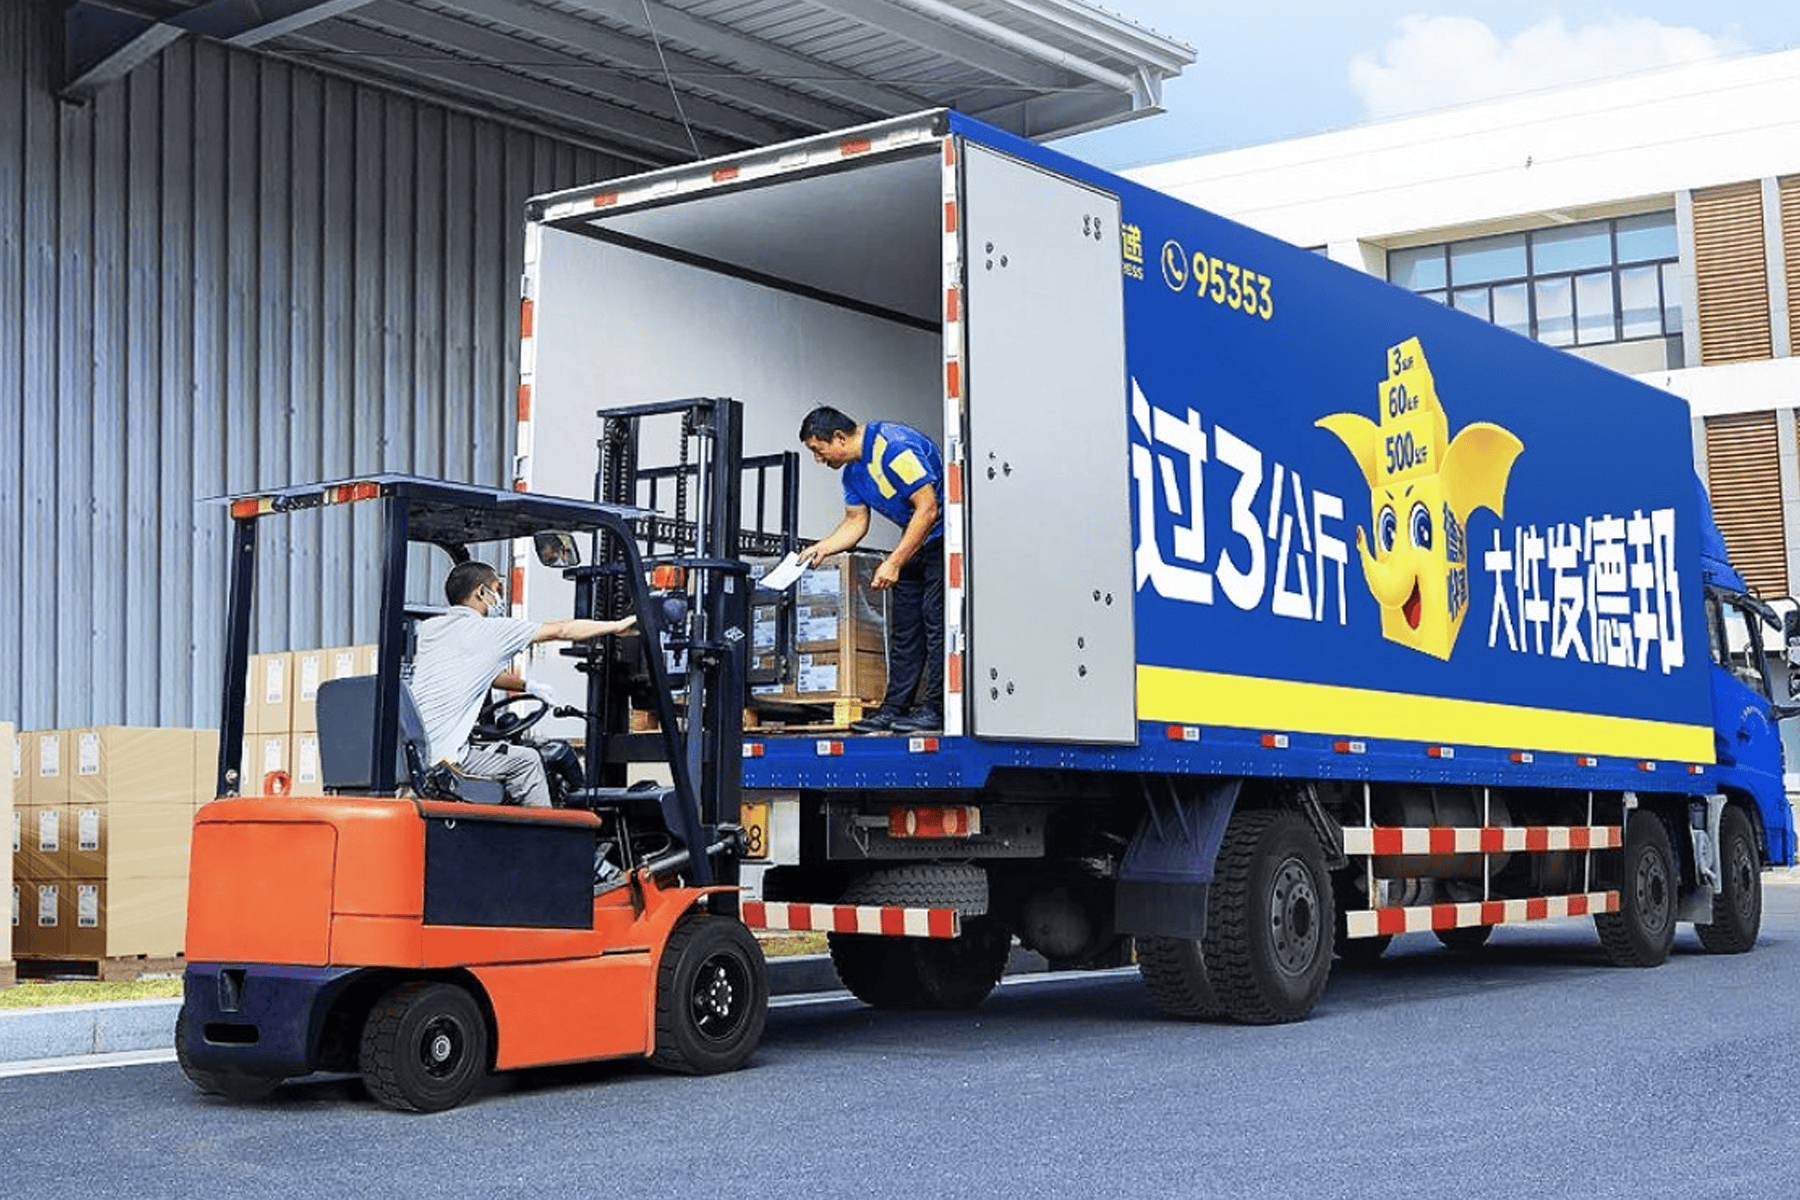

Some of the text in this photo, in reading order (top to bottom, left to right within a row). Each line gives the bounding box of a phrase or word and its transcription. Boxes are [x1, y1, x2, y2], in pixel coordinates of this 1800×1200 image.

[1192, 251, 1274, 321] 95353
[1484, 508, 1685, 675] 大件发德邦
